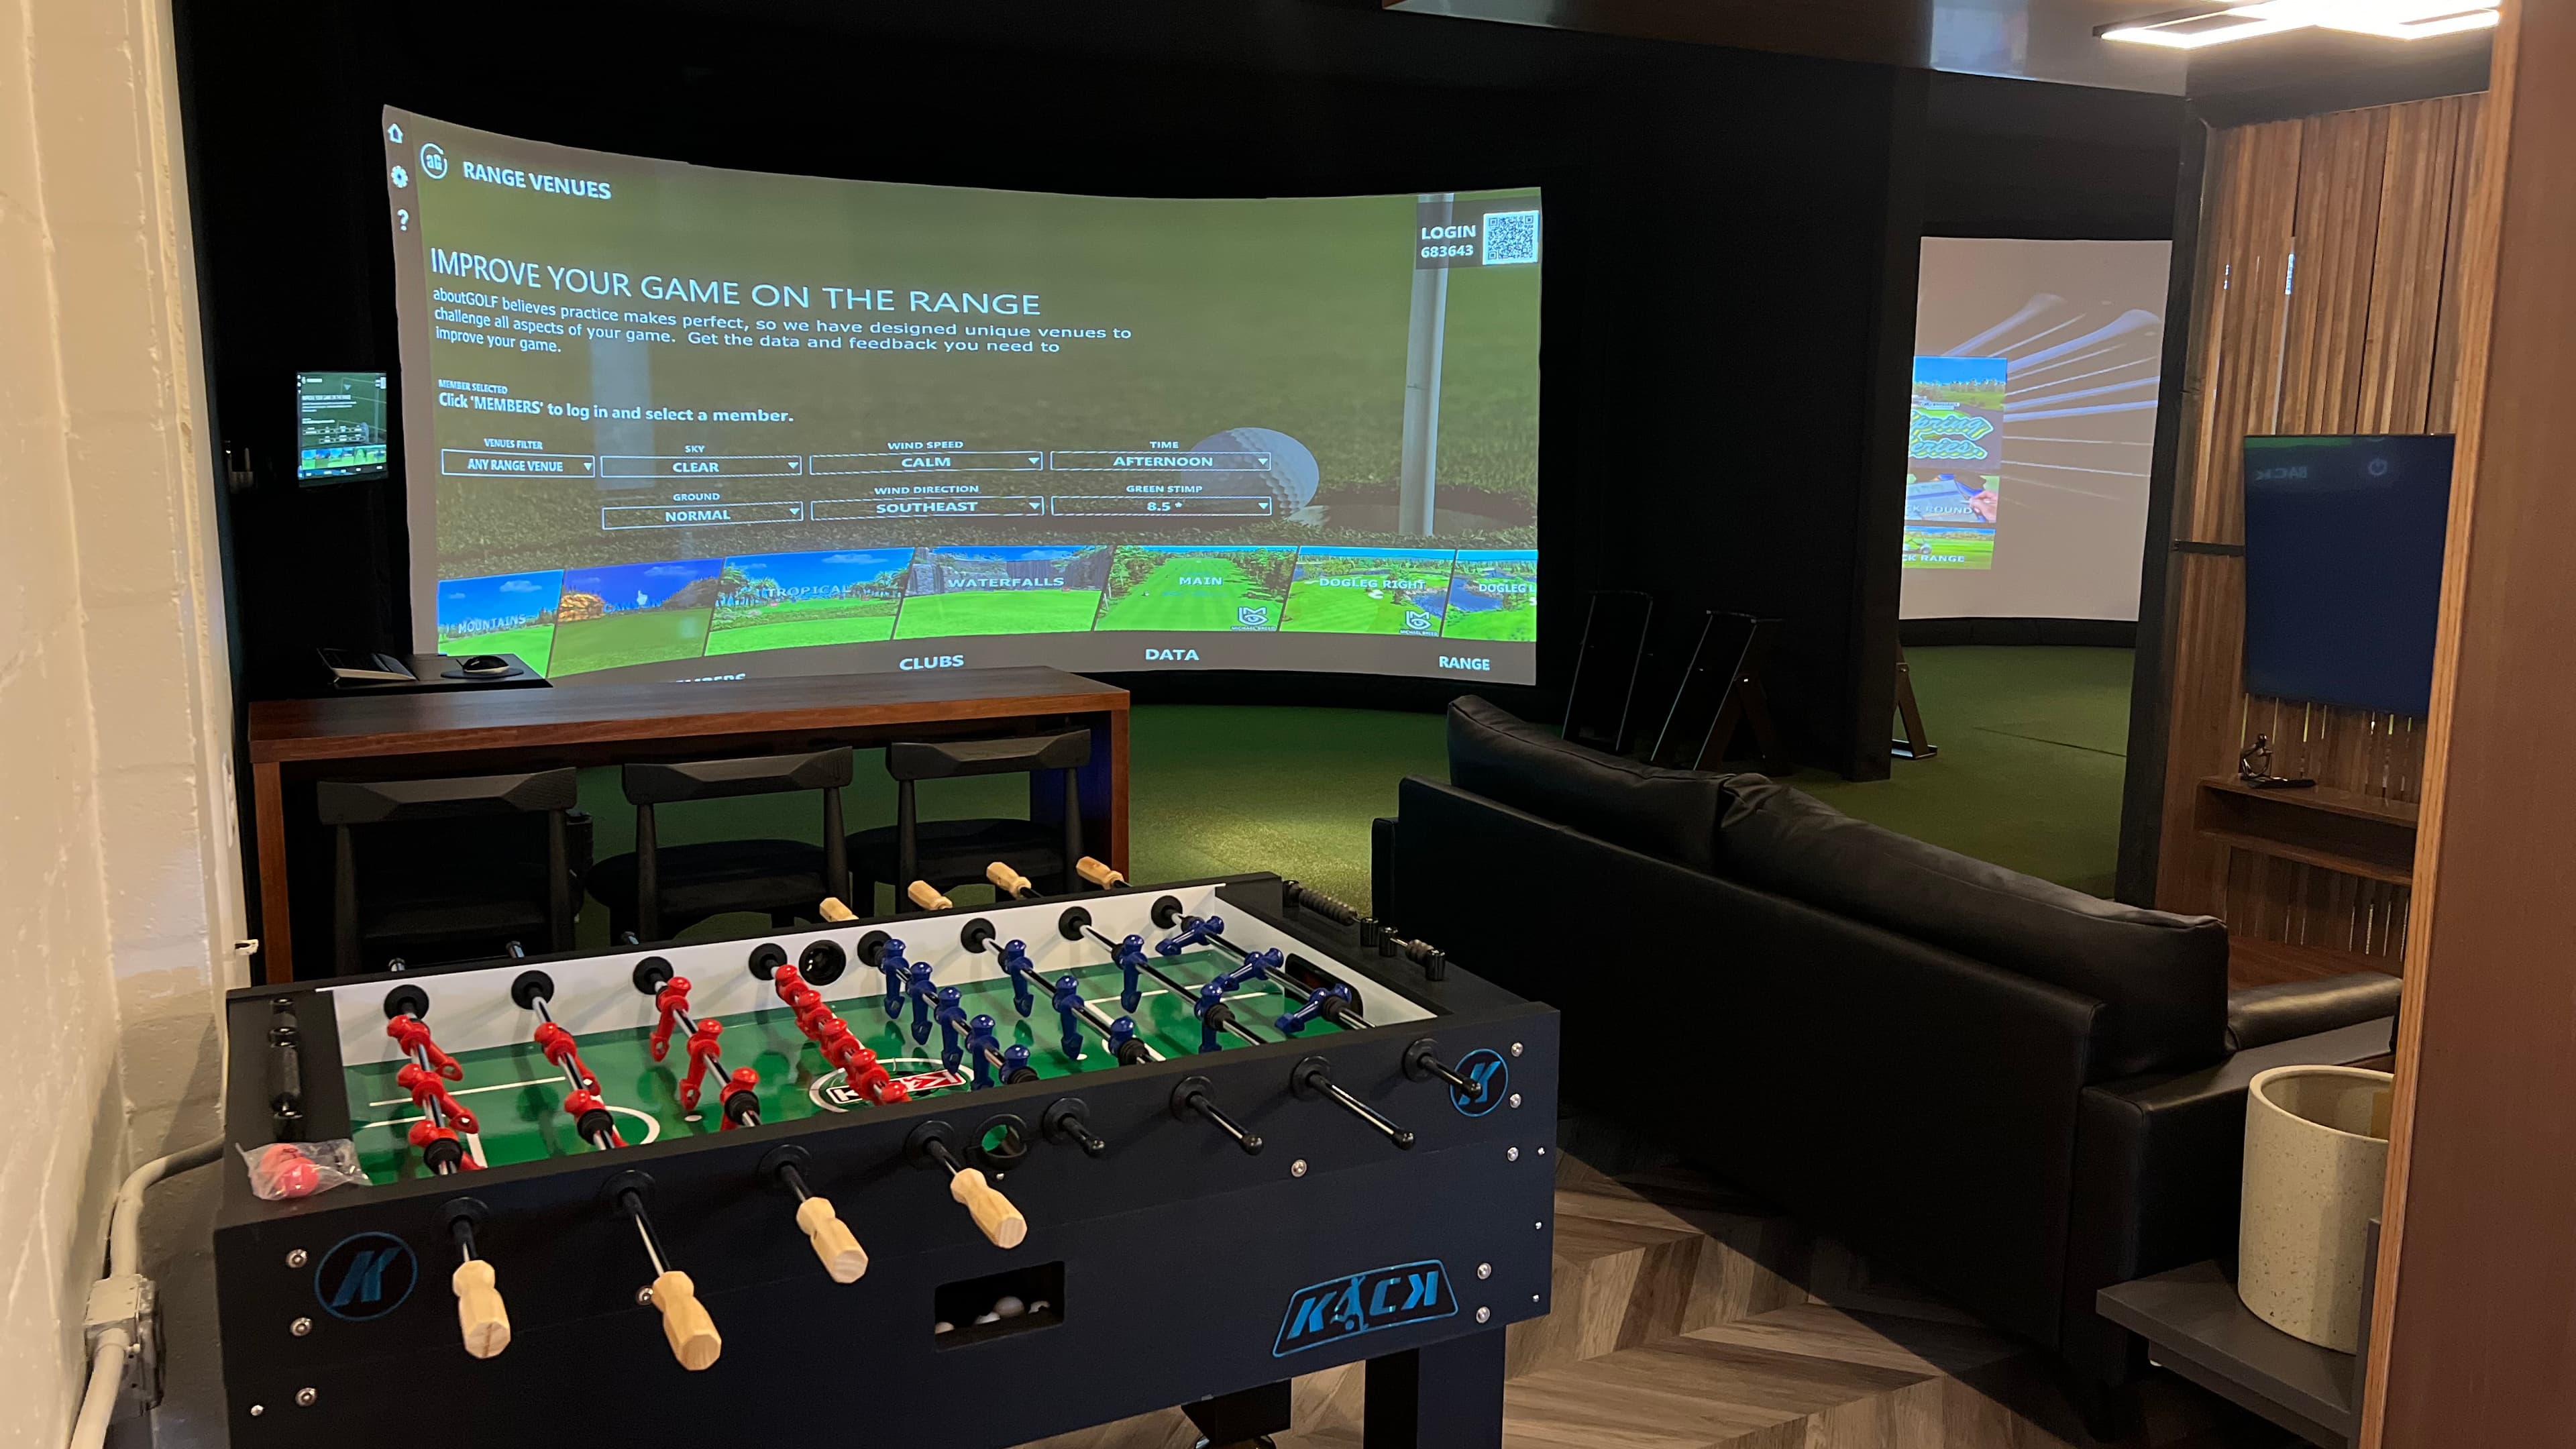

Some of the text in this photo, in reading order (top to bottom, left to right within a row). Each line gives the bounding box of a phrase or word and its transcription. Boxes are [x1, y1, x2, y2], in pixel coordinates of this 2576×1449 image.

[463, 161, 612, 200] RANGE VENUES
[1420, 225, 1476, 258] LOGIN 683643
[431, 248, 1042, 315] IMPROVE YOUR GAME ON THE RANGE
[433, 287, 1132, 339] aboutGOLF believes practice makes perfect, so we have designed unique venues to
[434, 306, 1060, 353] challenge all aspects of your game. Get the data and feedback you need to
[435, 325, 562, 353] improve your game.
[438, 378, 508, 394] MEMBER SELECTED
[438, 391, 794, 423] Click 'MEMBERS' to log in and select a member.
[484, 437, 543, 450] VENUES FILTER
[684, 445, 706, 453] SKY
[887, 441, 964, 451] WIND SPEED
[1149, 440, 1179, 449] TIME
[467, 458, 564, 473] ANY RANGE VENUE
[672, 461, 720, 474] CLEAR
[901, 456, 951, 468] CALM
[1112, 456, 1214, 468] AFTERNOON
[873, 484, 979, 495] WIND DIRECTION
[1126, 485, 1203, 494] GREEN STIMP
[672, 492, 721, 502] GROUND
[875, 501, 979, 514] SOUTHEAST
[1146, 502, 1171, 512] 8.5
[665, 509, 731, 523] NORMAL
[1921, 555, 1966, 563] RANGE
[948, 576, 1065, 588] WATERFALLS
[1179, 577, 1223, 586] MAIN
[1319, 578, 1427, 590] DOGLEG RIGHT
[1479, 583, 1526, 593] DOGLEG
[767, 584, 851, 598] TROPICAL
[458, 613, 527, 635] MOUNTAINS
[1145, 648, 1200, 661] DATA
[899, 654, 965, 670] CLUBS
[1439, 655, 1491, 671] RANGE
